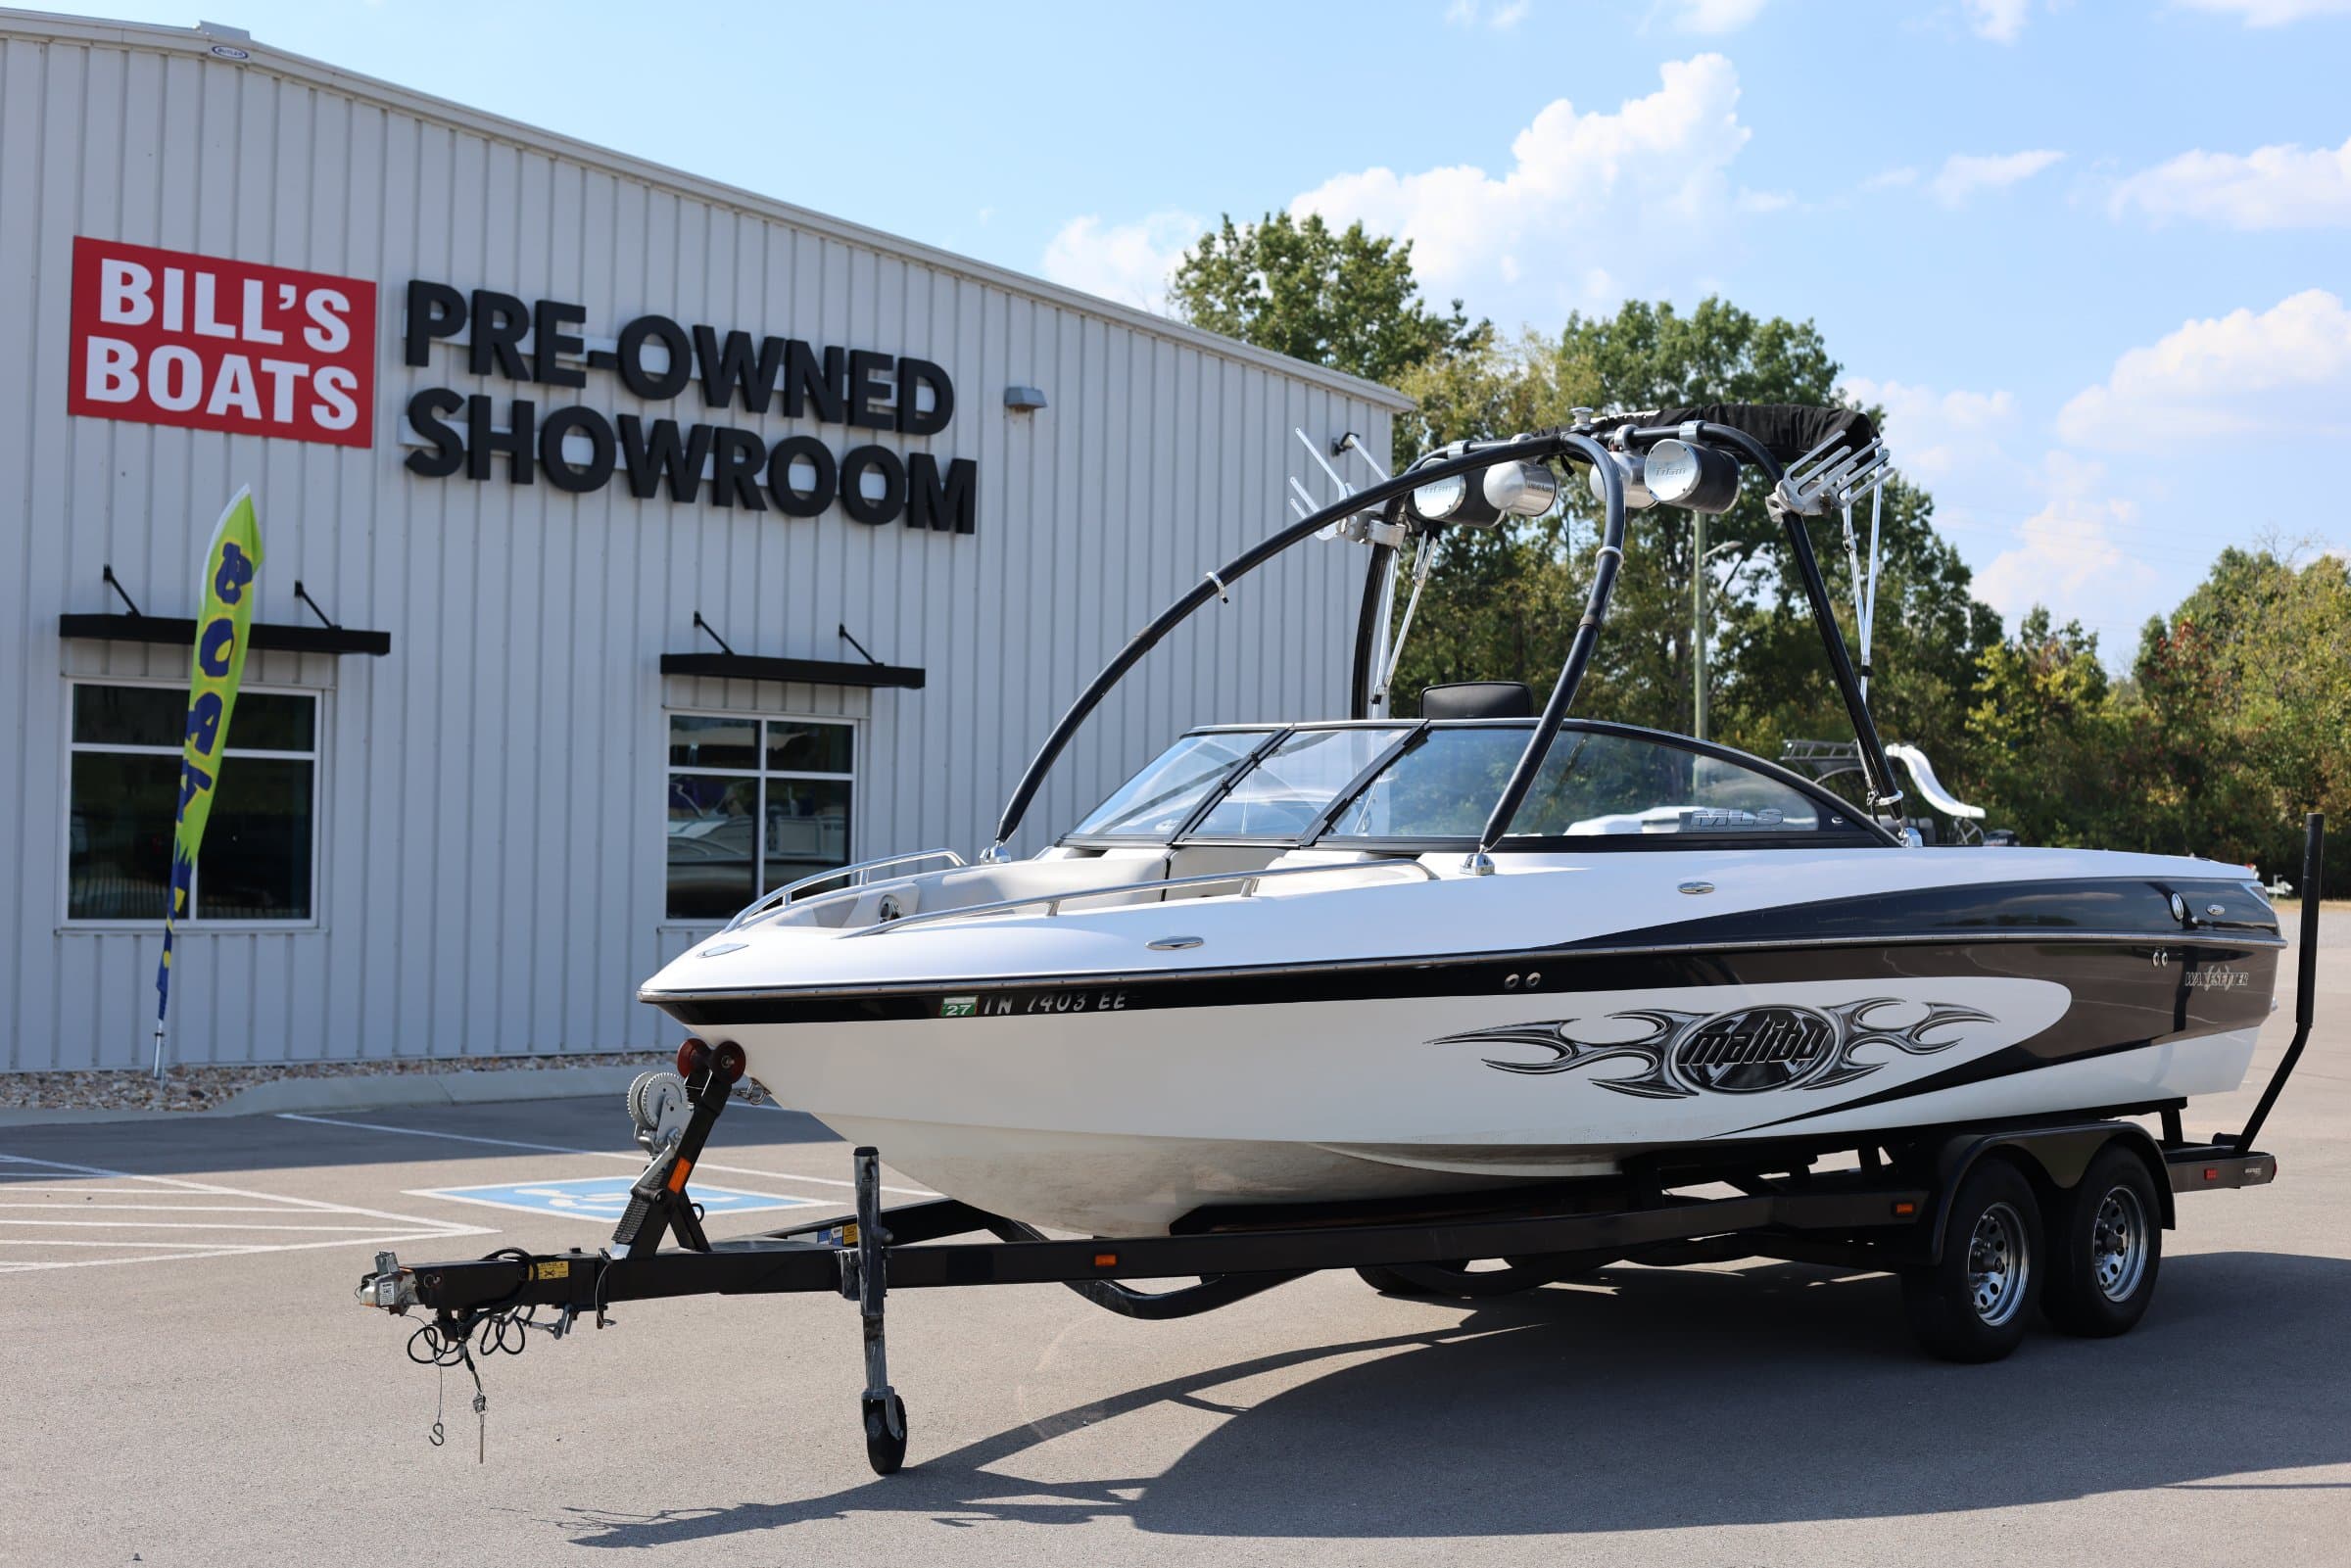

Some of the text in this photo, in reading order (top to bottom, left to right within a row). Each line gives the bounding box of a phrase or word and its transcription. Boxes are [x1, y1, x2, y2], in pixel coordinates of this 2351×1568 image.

[100, 257, 351, 354] BILL'S
[85, 335, 359, 431] BOATS
[406, 280, 955, 436] PRE-OWNED
[405, 387, 977, 535] SHOWROOM
[945, 1004, 972, 1017] 27
[1098, 990, 1127, 1010] EE
